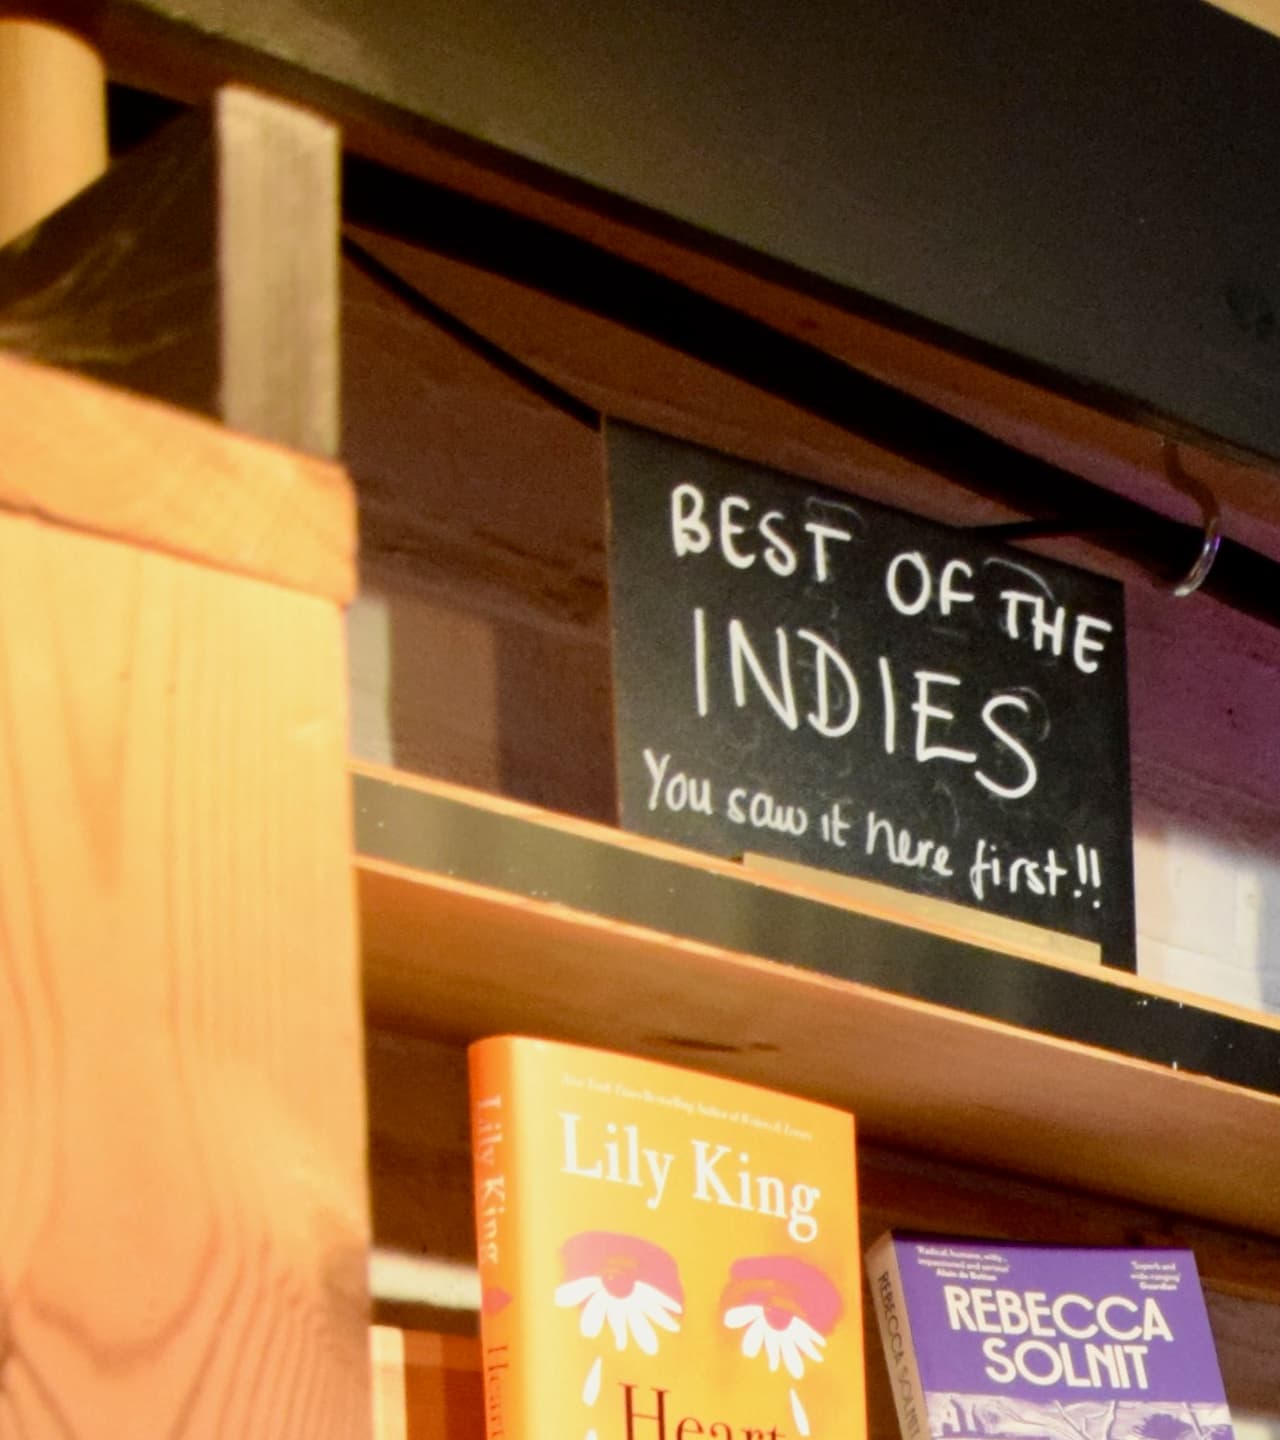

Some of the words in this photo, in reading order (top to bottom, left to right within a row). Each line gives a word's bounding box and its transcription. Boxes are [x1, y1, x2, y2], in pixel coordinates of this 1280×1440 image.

[670, 482, 851, 582] BEST
[885, 551, 975, 615] OF
[1000, 589, 1113, 674] THE
[693, 607, 1038, 800] INDIES
[642, 748, 714, 821] You
[725, 792, 808, 839] saw
[819, 804, 846, 851] it
[866, 815, 953, 882] here
[558, 1111, 675, 1210] Lily
[690, 1138, 820, 1243] King
[943, 1285, 1174, 1342] REBECCA
[983, 1340, 1148, 1389] SOLNIT
